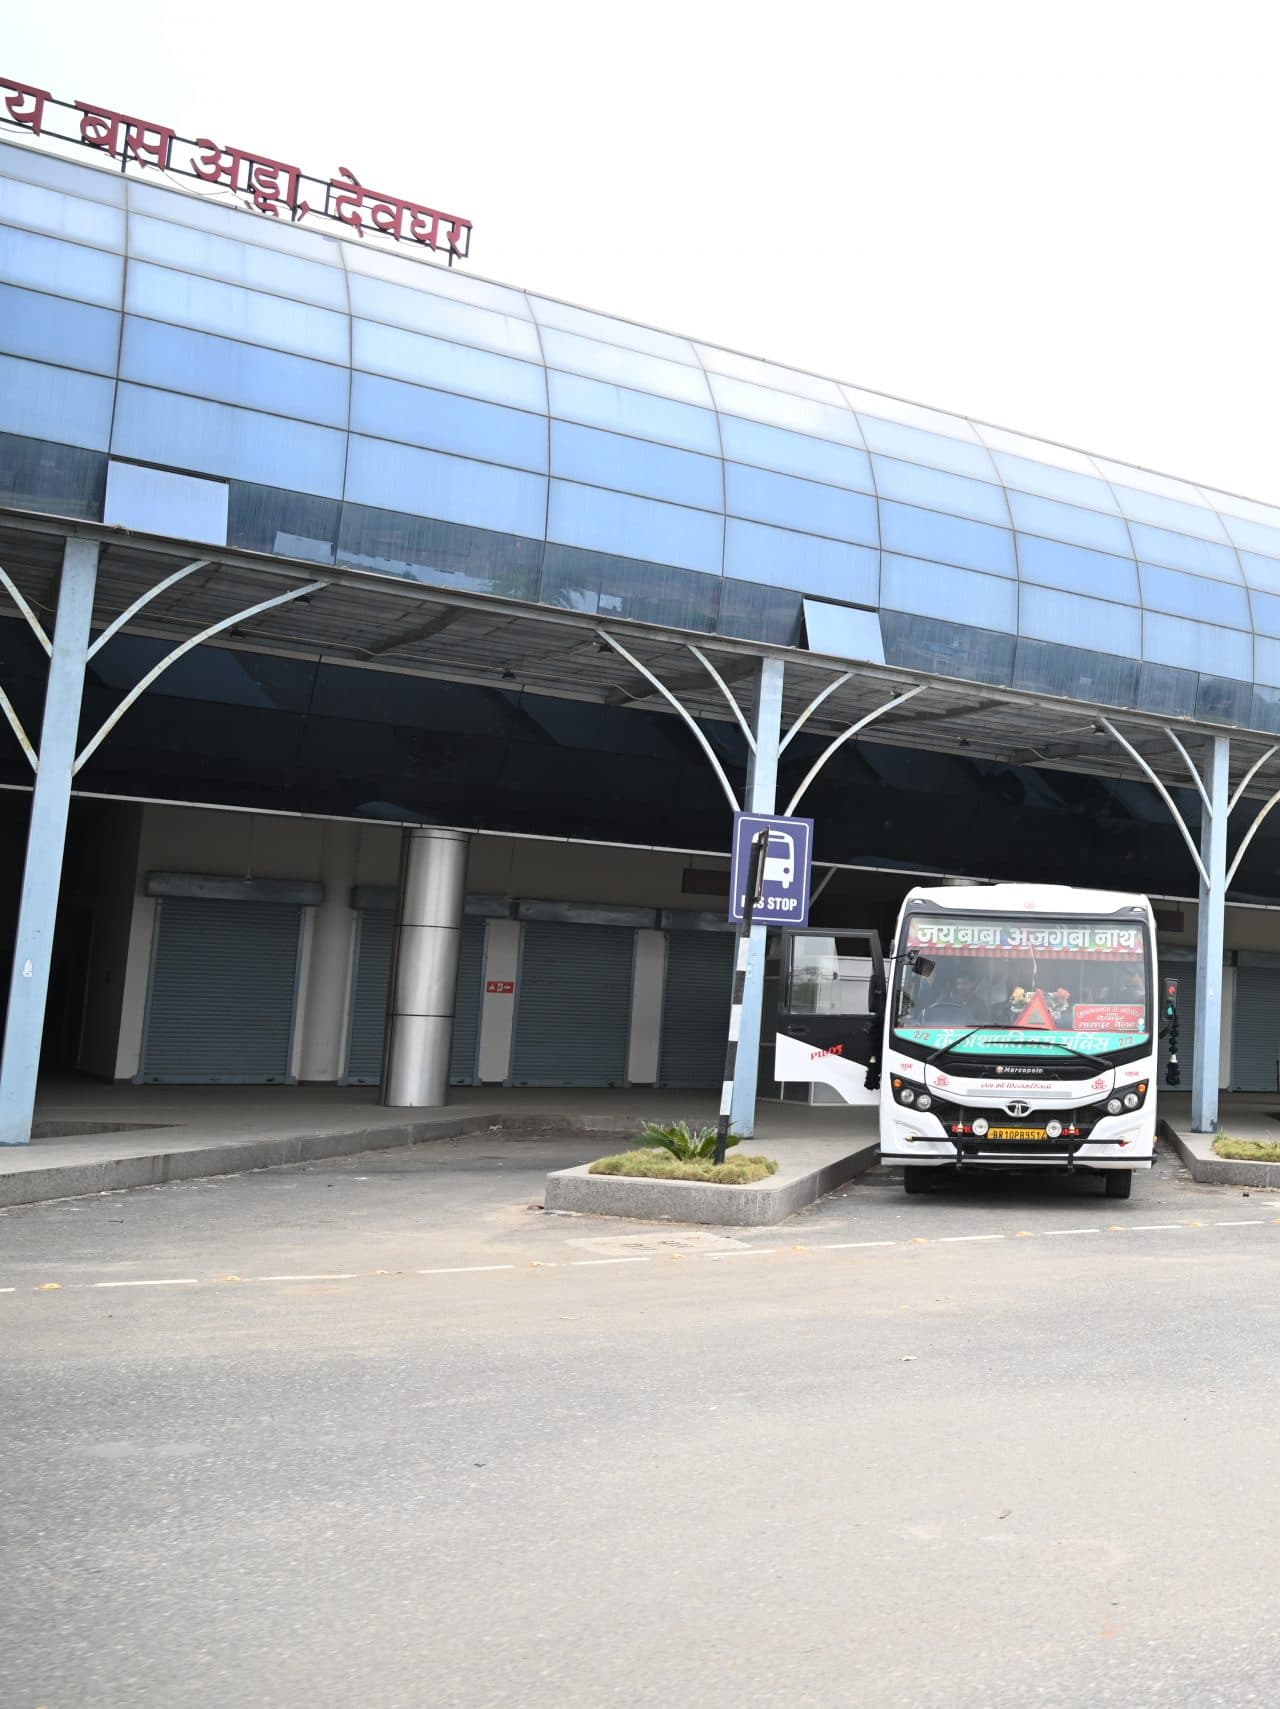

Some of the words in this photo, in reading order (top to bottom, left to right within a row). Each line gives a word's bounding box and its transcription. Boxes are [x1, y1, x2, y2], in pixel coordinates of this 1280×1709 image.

[74, 100, 176, 171] बस
[330, 166, 473, 259] देवघर
[767, 896, 798, 912] STOP
[1094, 929, 1137, 948] नाथ
[1003, 1066, 1044, 1075] Marcopolo
